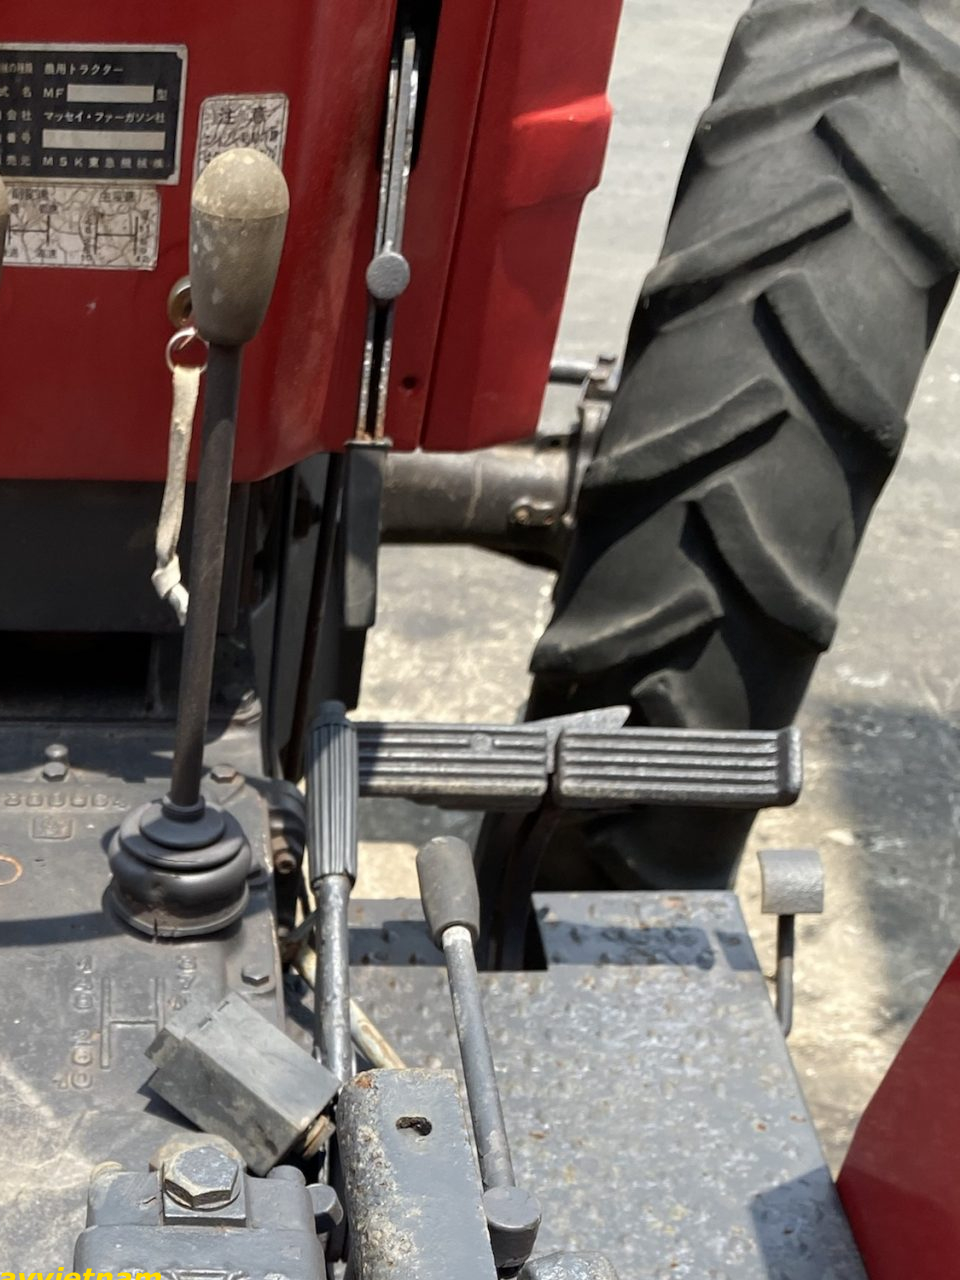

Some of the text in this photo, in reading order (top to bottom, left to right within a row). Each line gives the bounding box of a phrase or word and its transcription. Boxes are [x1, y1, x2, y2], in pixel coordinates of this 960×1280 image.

[43, 63, 124, 75] 農用トラクター
[43, 87, 64, 98] MF
[156, 88, 168, 101] 型
[43, 111, 166, 124] マッセイ・ファーガソン社
[219, 106, 267, 125] 注意
